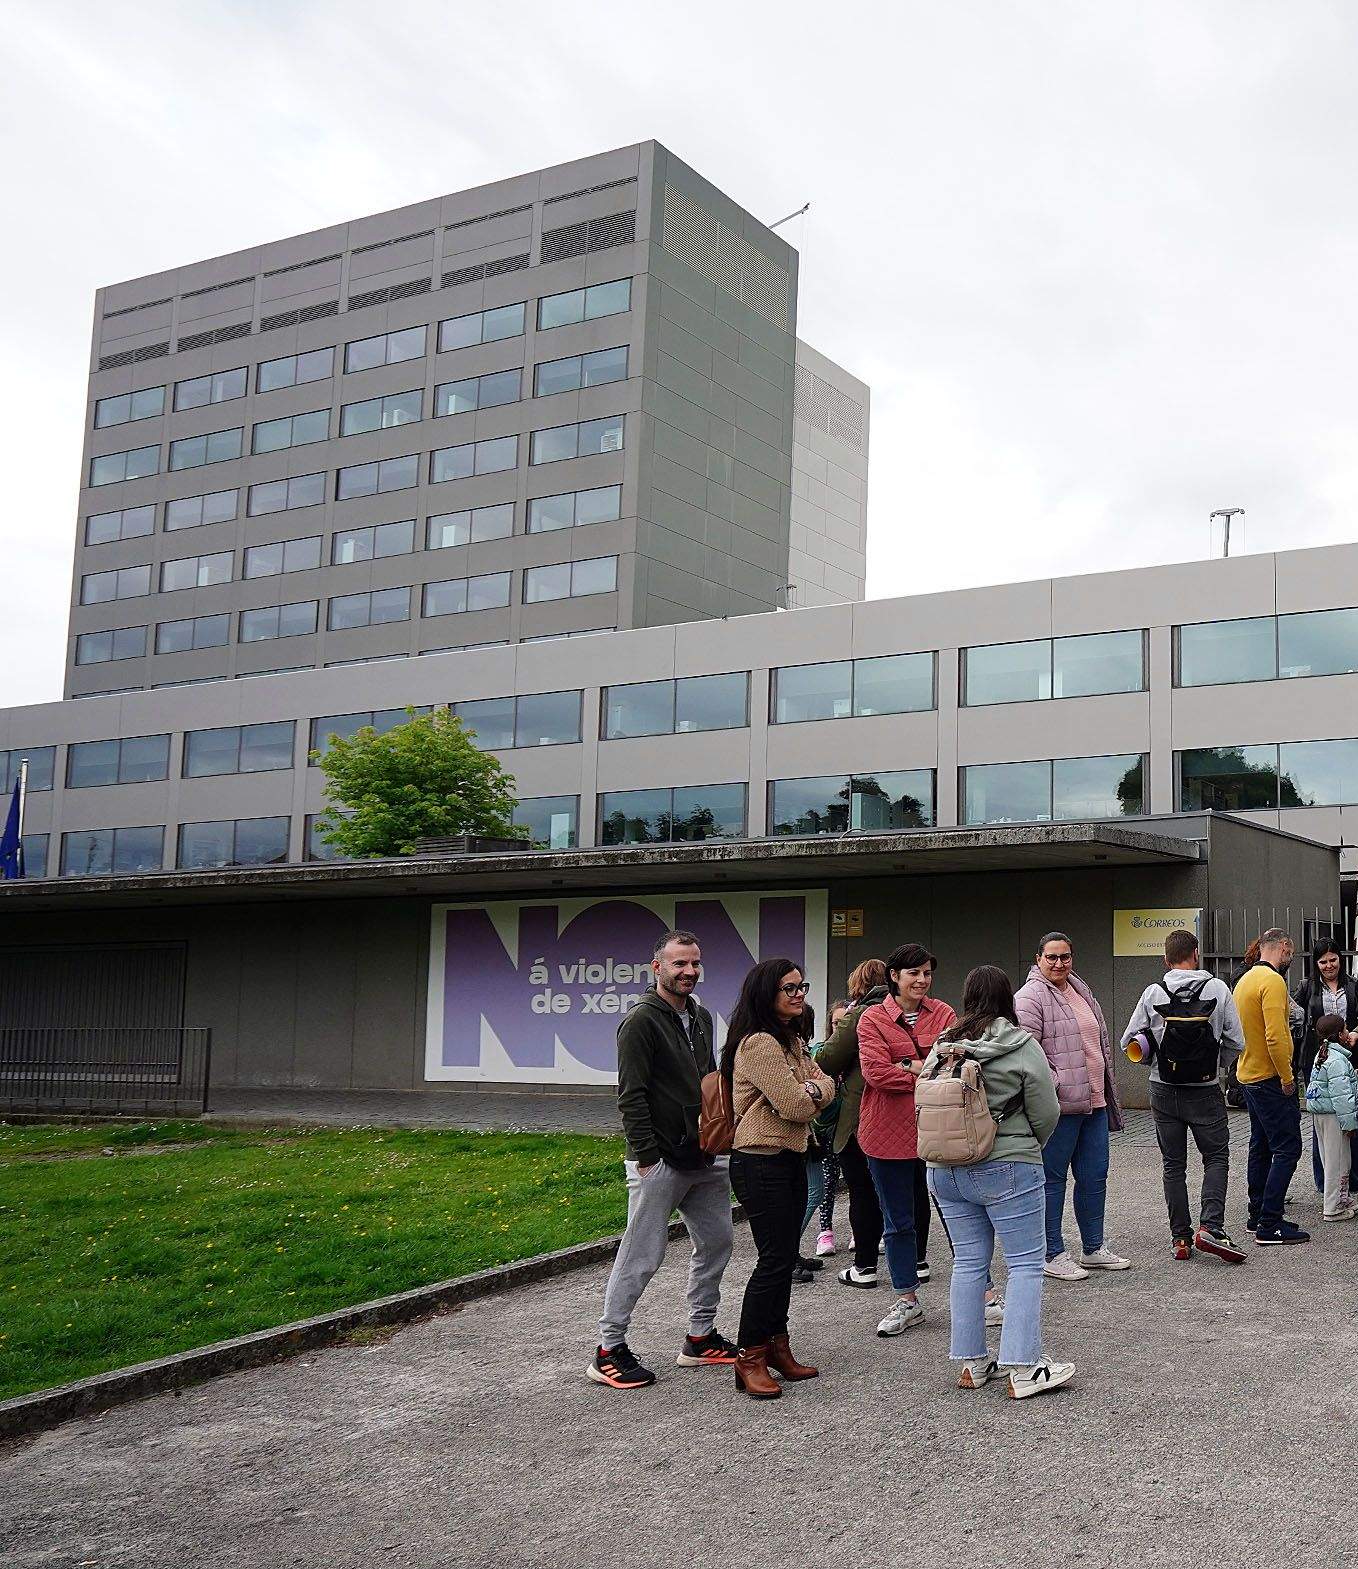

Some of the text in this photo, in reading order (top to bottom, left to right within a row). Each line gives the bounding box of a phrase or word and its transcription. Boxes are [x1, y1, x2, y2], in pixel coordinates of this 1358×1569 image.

[1144, 918, 1185, 928] CORREOS
[528, 957, 704, 985] á violen
[530, 986, 701, 1014] de xén
